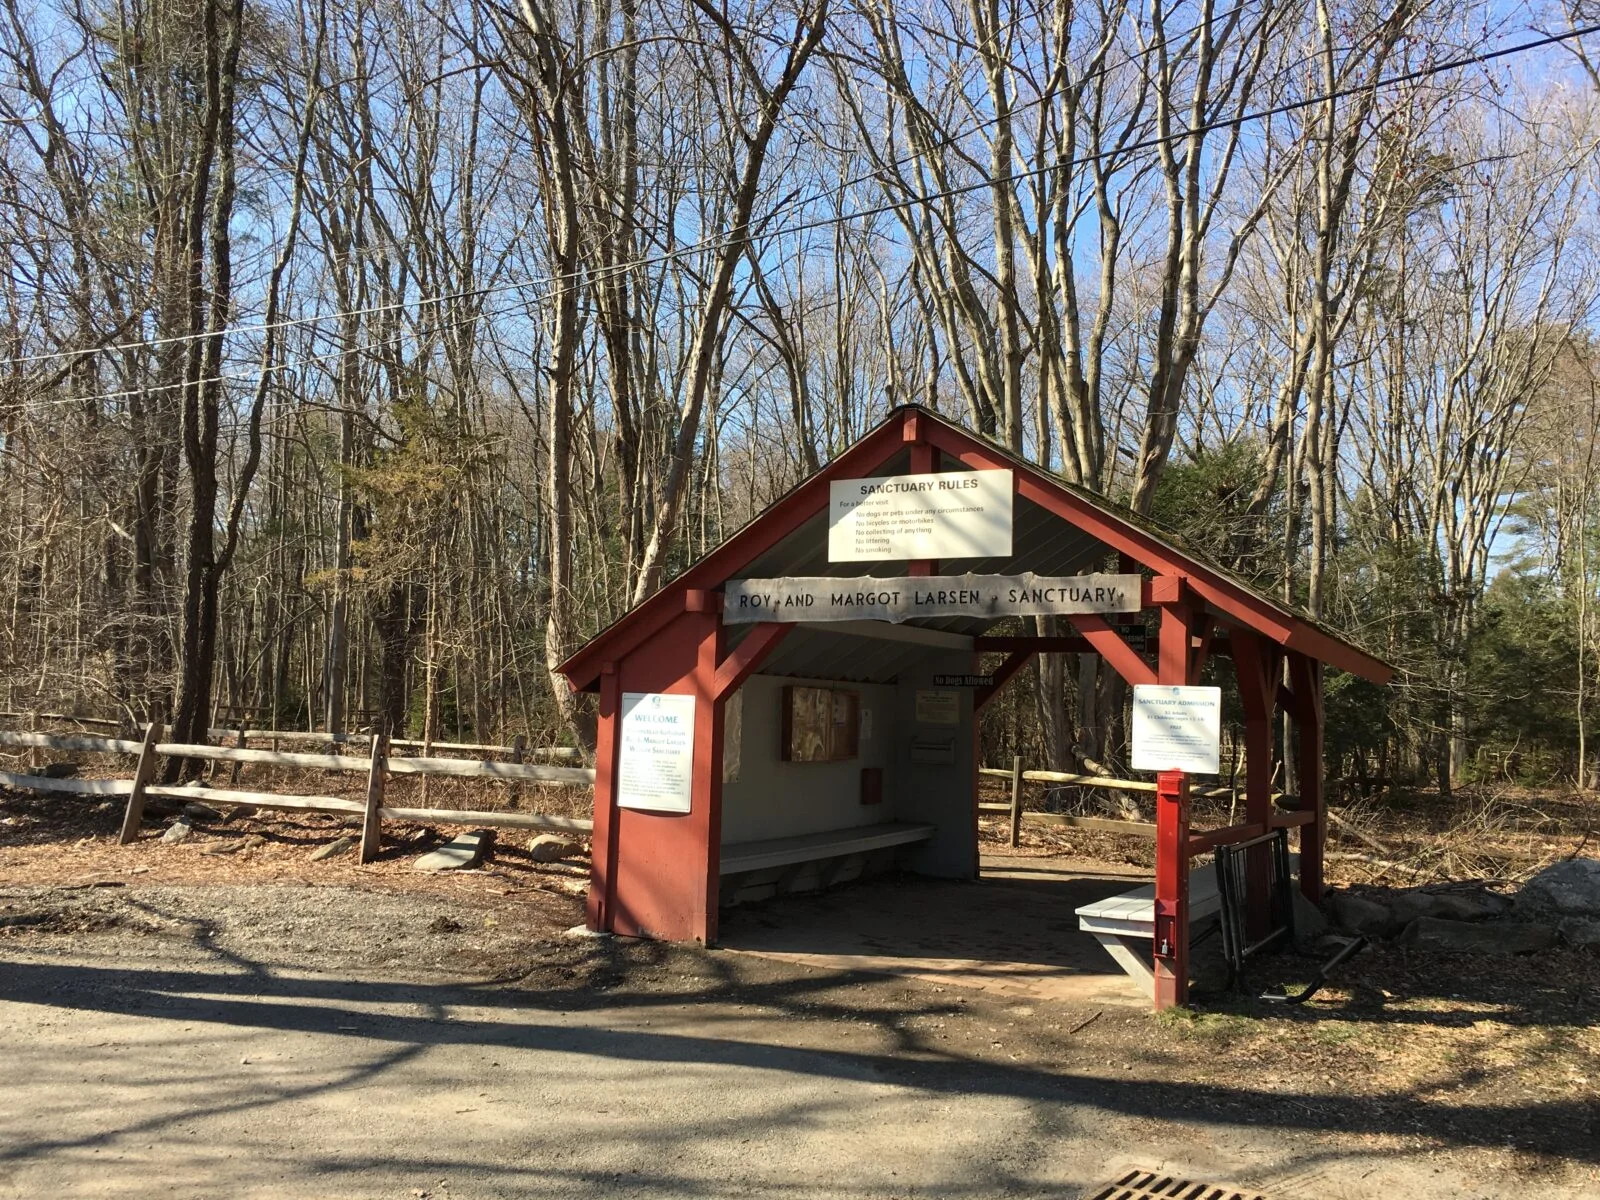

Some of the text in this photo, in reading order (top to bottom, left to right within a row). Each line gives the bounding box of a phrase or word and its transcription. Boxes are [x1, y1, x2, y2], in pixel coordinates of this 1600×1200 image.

[860, 479, 978, 495] SANCTUARY RULES
[866, 528, 895, 537] collecting
[740, 587, 1116, 608] ROY AND MARGOT LARSEN SANCTUARY
[935, 676, 993, 686] No Dogs Allowed
[635, 714, 678, 723] WELCOME
